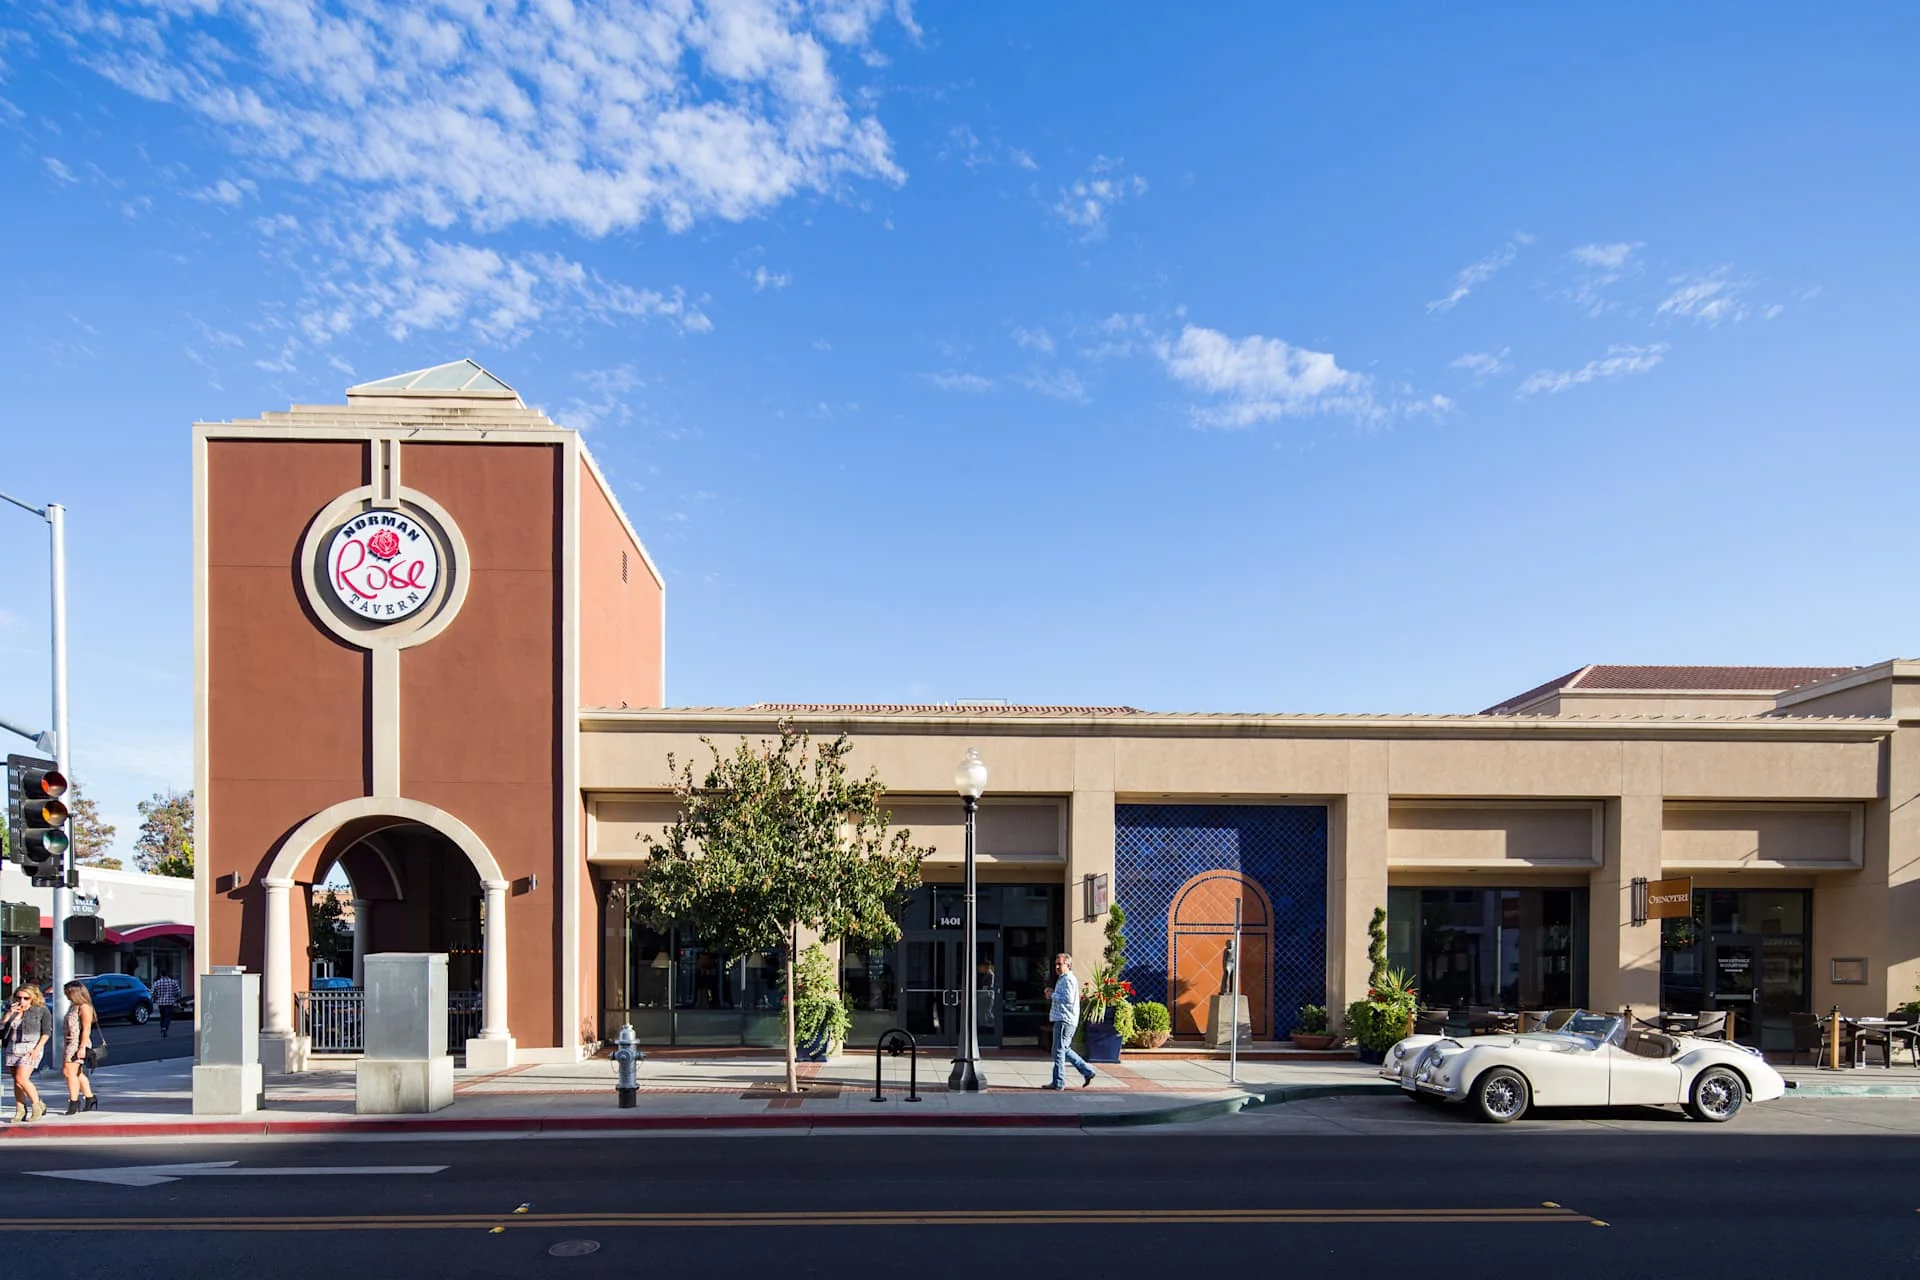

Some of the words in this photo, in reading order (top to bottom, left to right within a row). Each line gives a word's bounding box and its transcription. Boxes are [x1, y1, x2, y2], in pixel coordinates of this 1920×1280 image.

[343, 515, 420, 542] NORMAN
[336, 539, 427, 600] Rose
[350, 592, 419, 615] TAVERN
[940, 917, 961, 926] 1401
